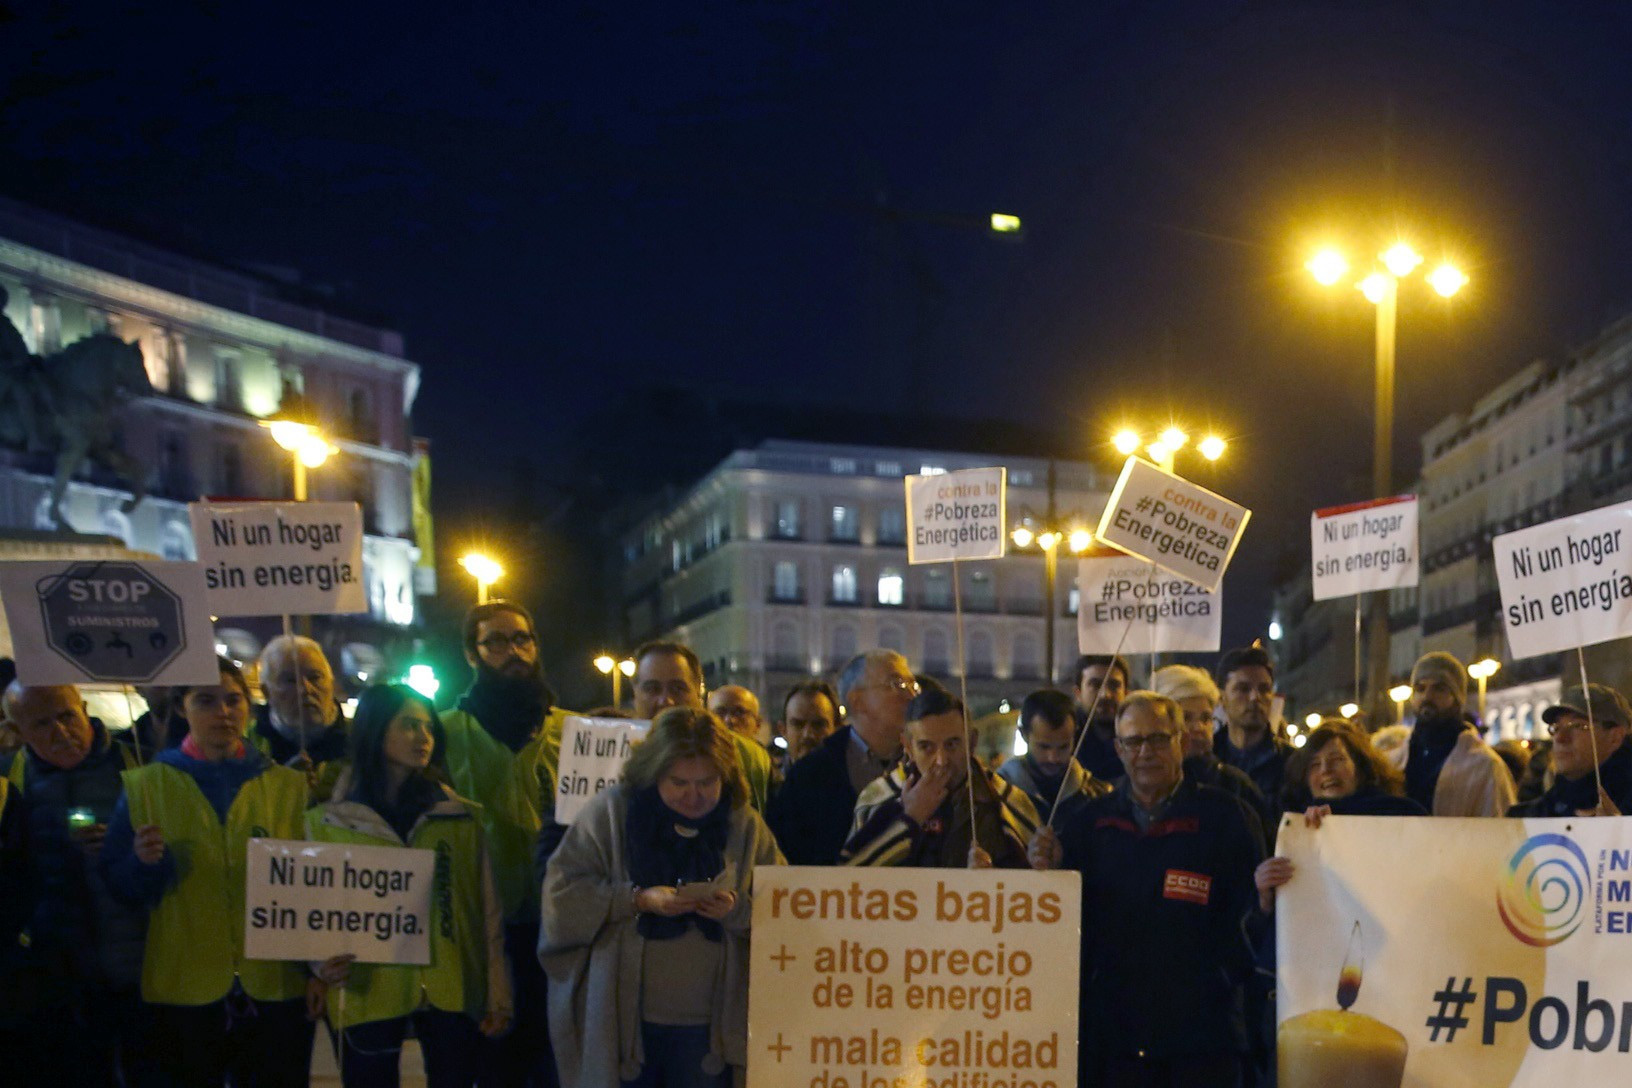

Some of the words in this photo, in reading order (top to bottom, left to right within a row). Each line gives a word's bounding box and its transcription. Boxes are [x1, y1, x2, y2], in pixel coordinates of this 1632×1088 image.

[938, 484, 980, 499] contra
[985, 481, 997, 496] la
[924, 502, 997, 521] #Pobreza
[1135, 496, 1230, 551] #Pobreza
[1163, 487, 1218, 522] contra
[1222, 510, 1237, 531] la
[211, 518, 236, 546] Ni
[243, 523, 272, 545] un
[277, 518, 343, 550] hogar
[915, 522, 998, 547] Energética
[1113, 508, 1220, 571] Energética
[1324, 520, 1338, 543] Ni
[1342, 522, 1358, 540] un
[1362, 514, 1403, 539] hogar
[1316, 554, 1340, 577] sin
[1345, 543, 1412, 572] energía.
[1512, 547, 1533, 579] Ni
[1538, 547, 1563, 573] un
[1567, 528, 1622, 565] hogar
[67, 578, 150, 603] STOP
[205, 561, 246, 589] sin
[254, 557, 358, 591] energía.
[1094, 599, 1211, 623] Energética
[1509, 595, 1544, 626] sin
[573, 731, 592, 756] Ni
[595, 738, 617, 758] un
[560, 770, 588, 795] sin
[270, 856, 295, 885] Ni
[303, 865, 333, 888] un
[343, 860, 414, 897] hogar
[251, 900, 297, 929] sin
[307, 905, 424, 940] energía.
[769, 883, 919, 924] rentas
[935, 880, 1063, 933] bajas
[769, 944, 796, 973] +
[814, 940, 889, 975] alto
[904, 942, 1033, 983] precio
[812, 975, 854, 1009] de
[866, 975, 894, 1009] la
[905, 977, 1033, 1020] energía
[767, 1032, 792, 1063] +
[809, 1028, 901, 1068] mala
[916, 1030, 1060, 1070] calidad
